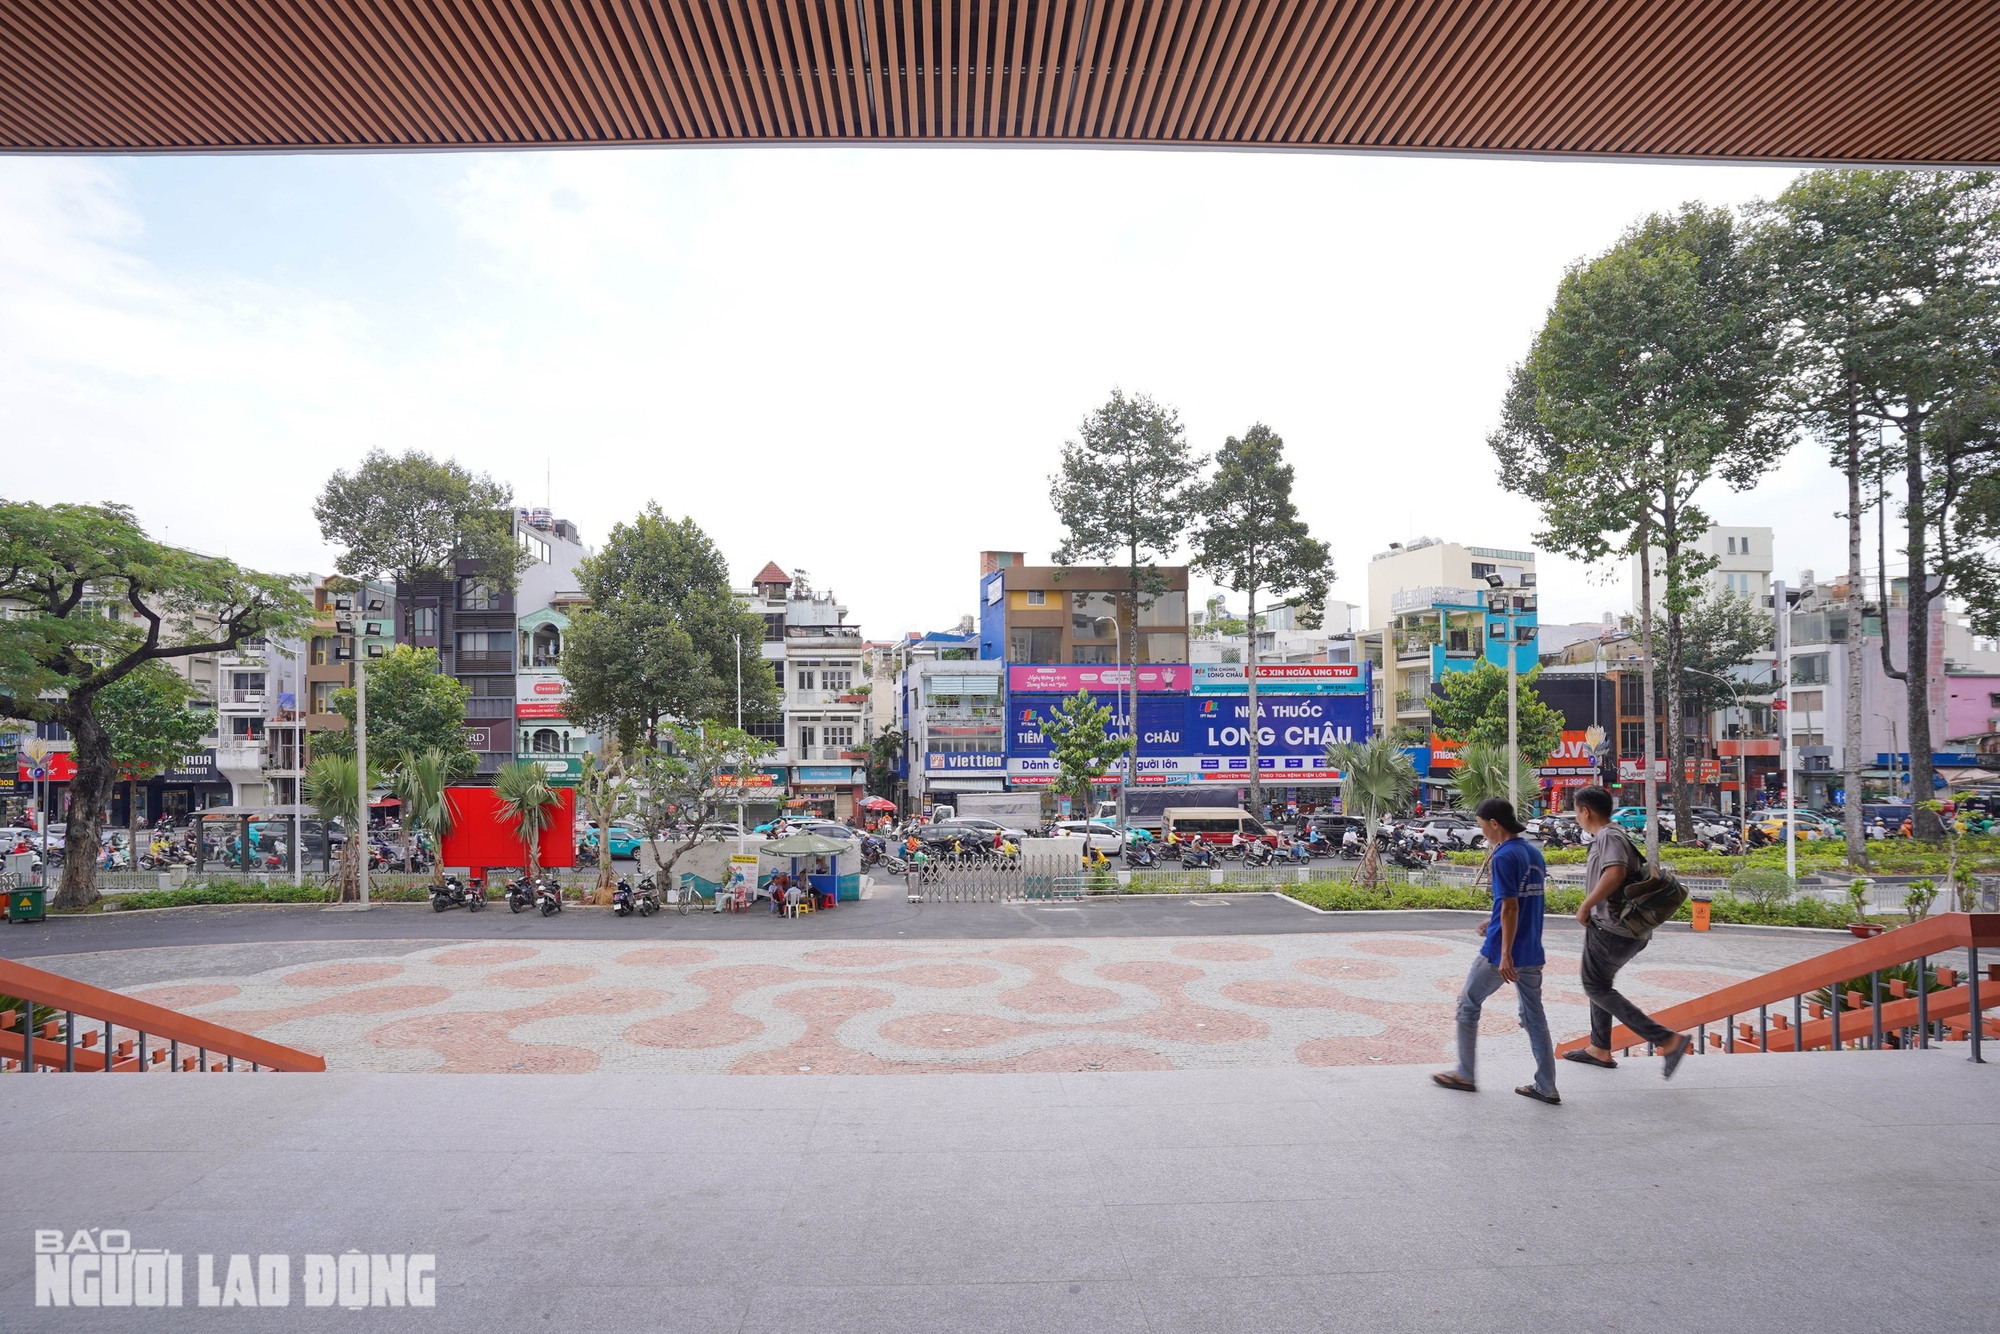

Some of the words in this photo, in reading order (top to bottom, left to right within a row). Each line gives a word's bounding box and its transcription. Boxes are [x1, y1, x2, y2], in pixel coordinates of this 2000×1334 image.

[1286, 667, 1311, 676] NGỪA
[1334, 667, 1352, 676] THƯ
[1272, 699, 1323, 718] THUỐC
[1018, 730, 1044, 744] TIÊM
[1144, 730, 1179, 744] CHÂU
[1285, 721, 1351, 746] CHÂU
[949, 754, 1001, 767] viettien
[1022, 760, 1048, 770] Dành
[1137, 759, 1159, 771] gười
[1163, 759, 1178, 769] lớn
[1217, 771, 1239, 779] CHUYÊN
